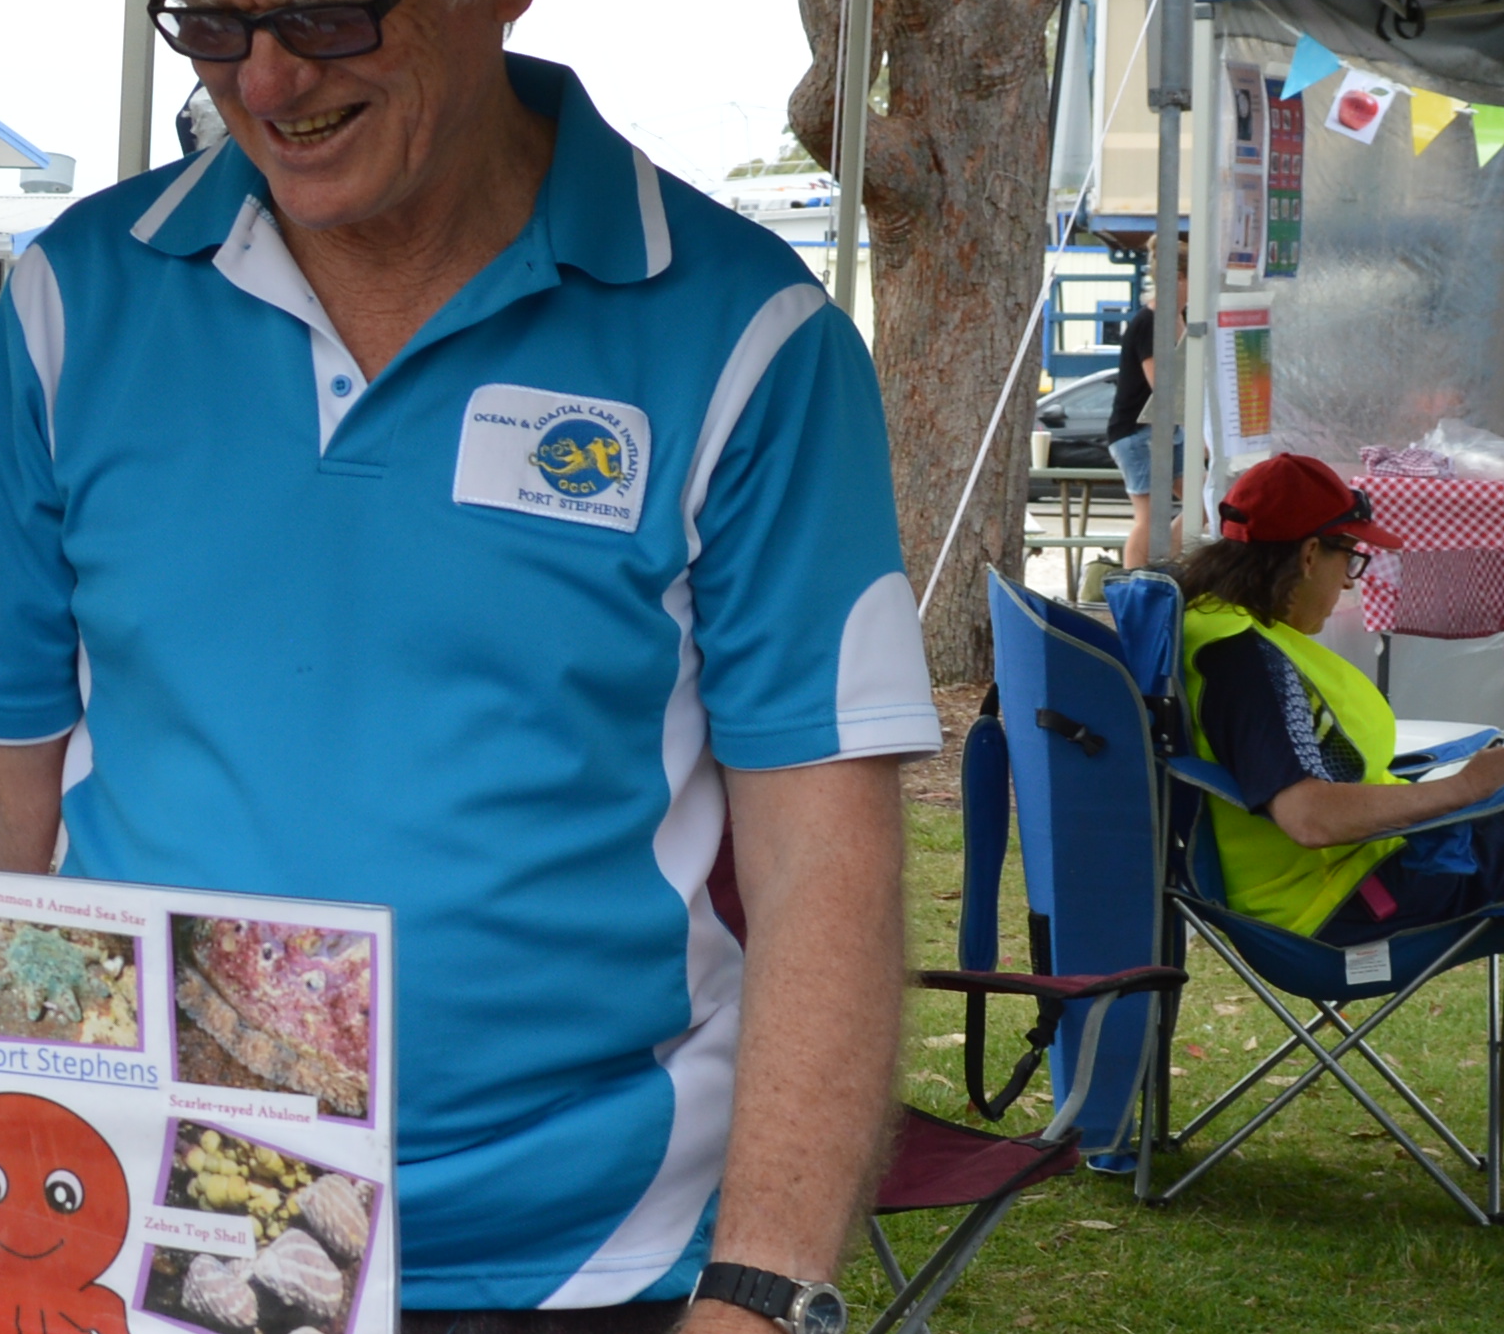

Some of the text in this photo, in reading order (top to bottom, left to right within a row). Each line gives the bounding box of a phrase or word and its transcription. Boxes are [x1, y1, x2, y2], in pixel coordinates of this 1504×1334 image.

[473, 412, 516, 427] OCEAN
[521, 419, 531, 430] &
[533, 404, 584, 431] COASTAL
[589, 405, 620, 429] CARE
[557, 478, 597, 494] OCCI
[518, 488, 630, 519] PORT STEPHENS
[36, 897, 44, 909] 8
[46, 899, 91, 918] Armed
[95, 905, 118, 922] Sea
[120, 910, 147, 927] Star
[38, 1047, 159, 1085] Stephens
[169, 1094, 312, 1124] Scarlet-rayed Abalone
[144, 1216, 247, 1245] Zebra Top Shell
